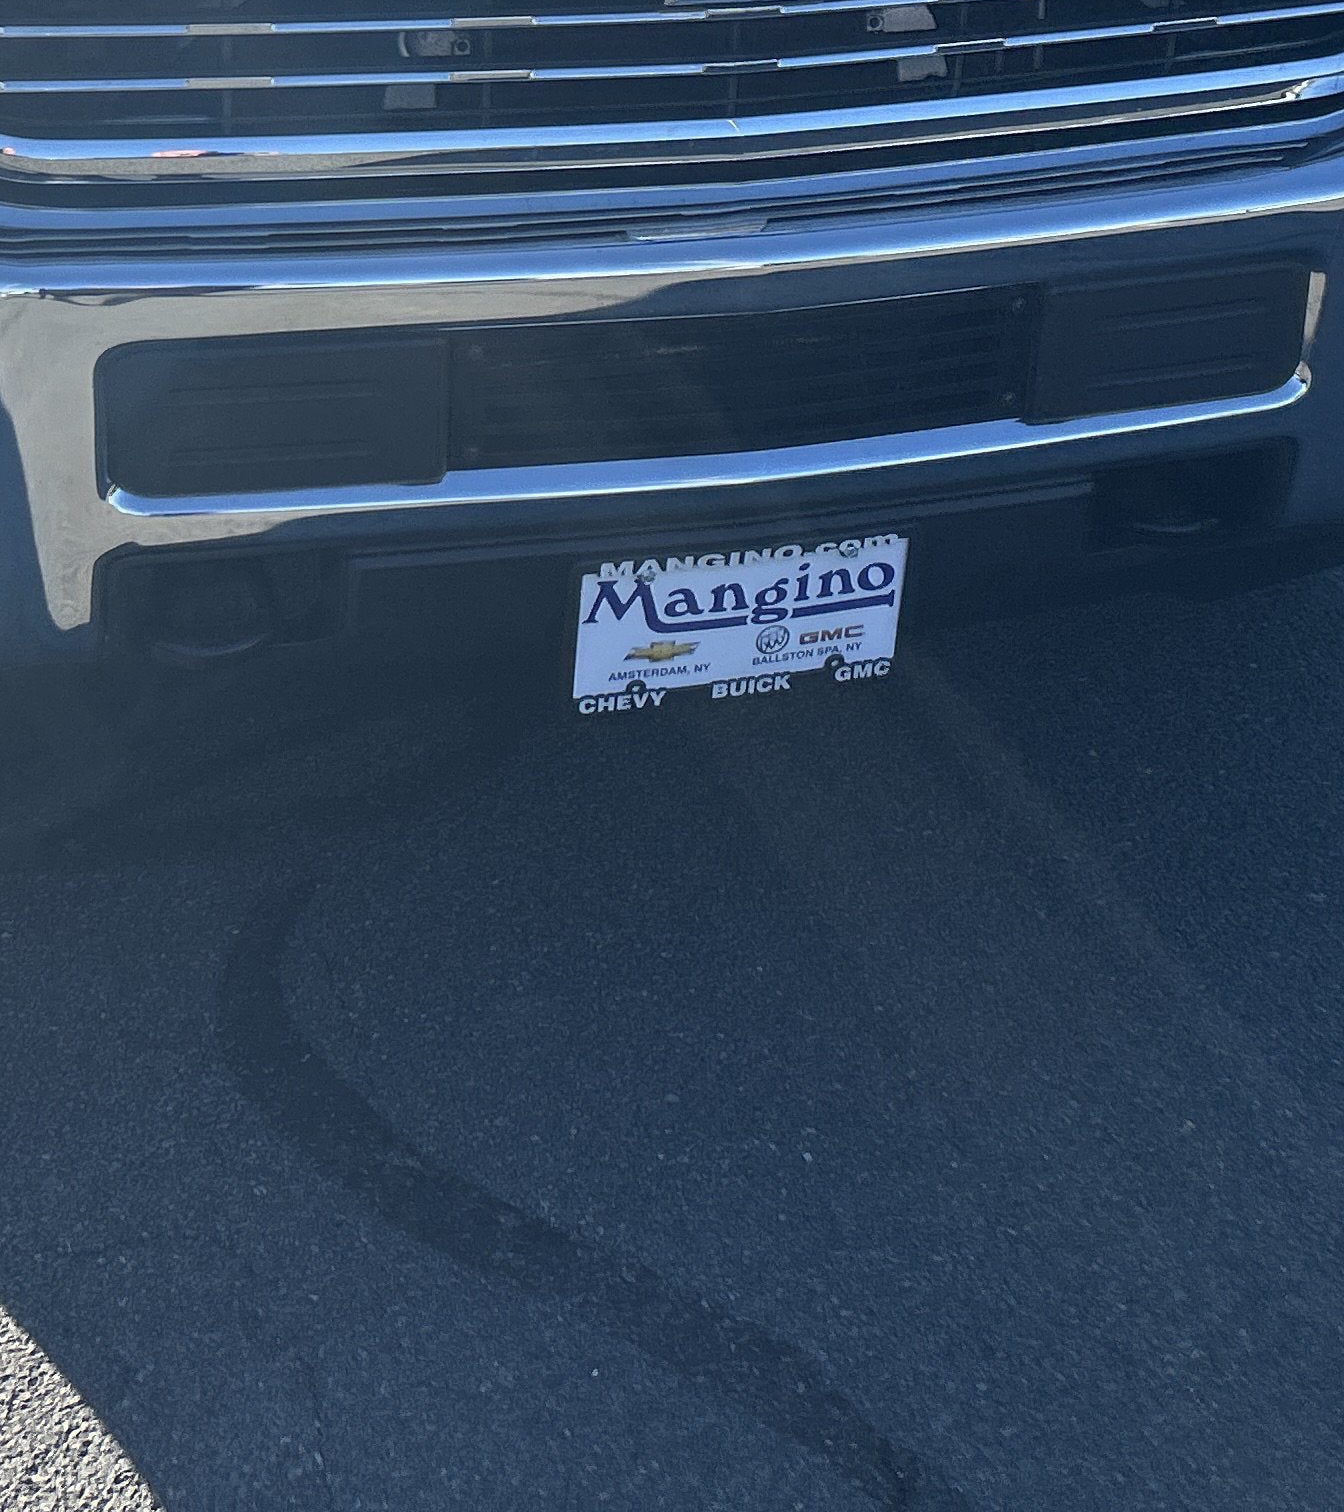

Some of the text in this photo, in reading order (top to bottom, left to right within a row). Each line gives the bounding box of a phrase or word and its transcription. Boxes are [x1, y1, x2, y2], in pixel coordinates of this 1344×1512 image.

[582, 562, 896, 633] Mangino
[799, 624, 865, 646] GMC
[752, 648, 814, 666] BALLSTON
[846, 641, 862, 653] NY
[608, 662, 711, 682] AMSTERDAM, NY
[578, 660, 891, 715] CHEVY BUICK GMC
